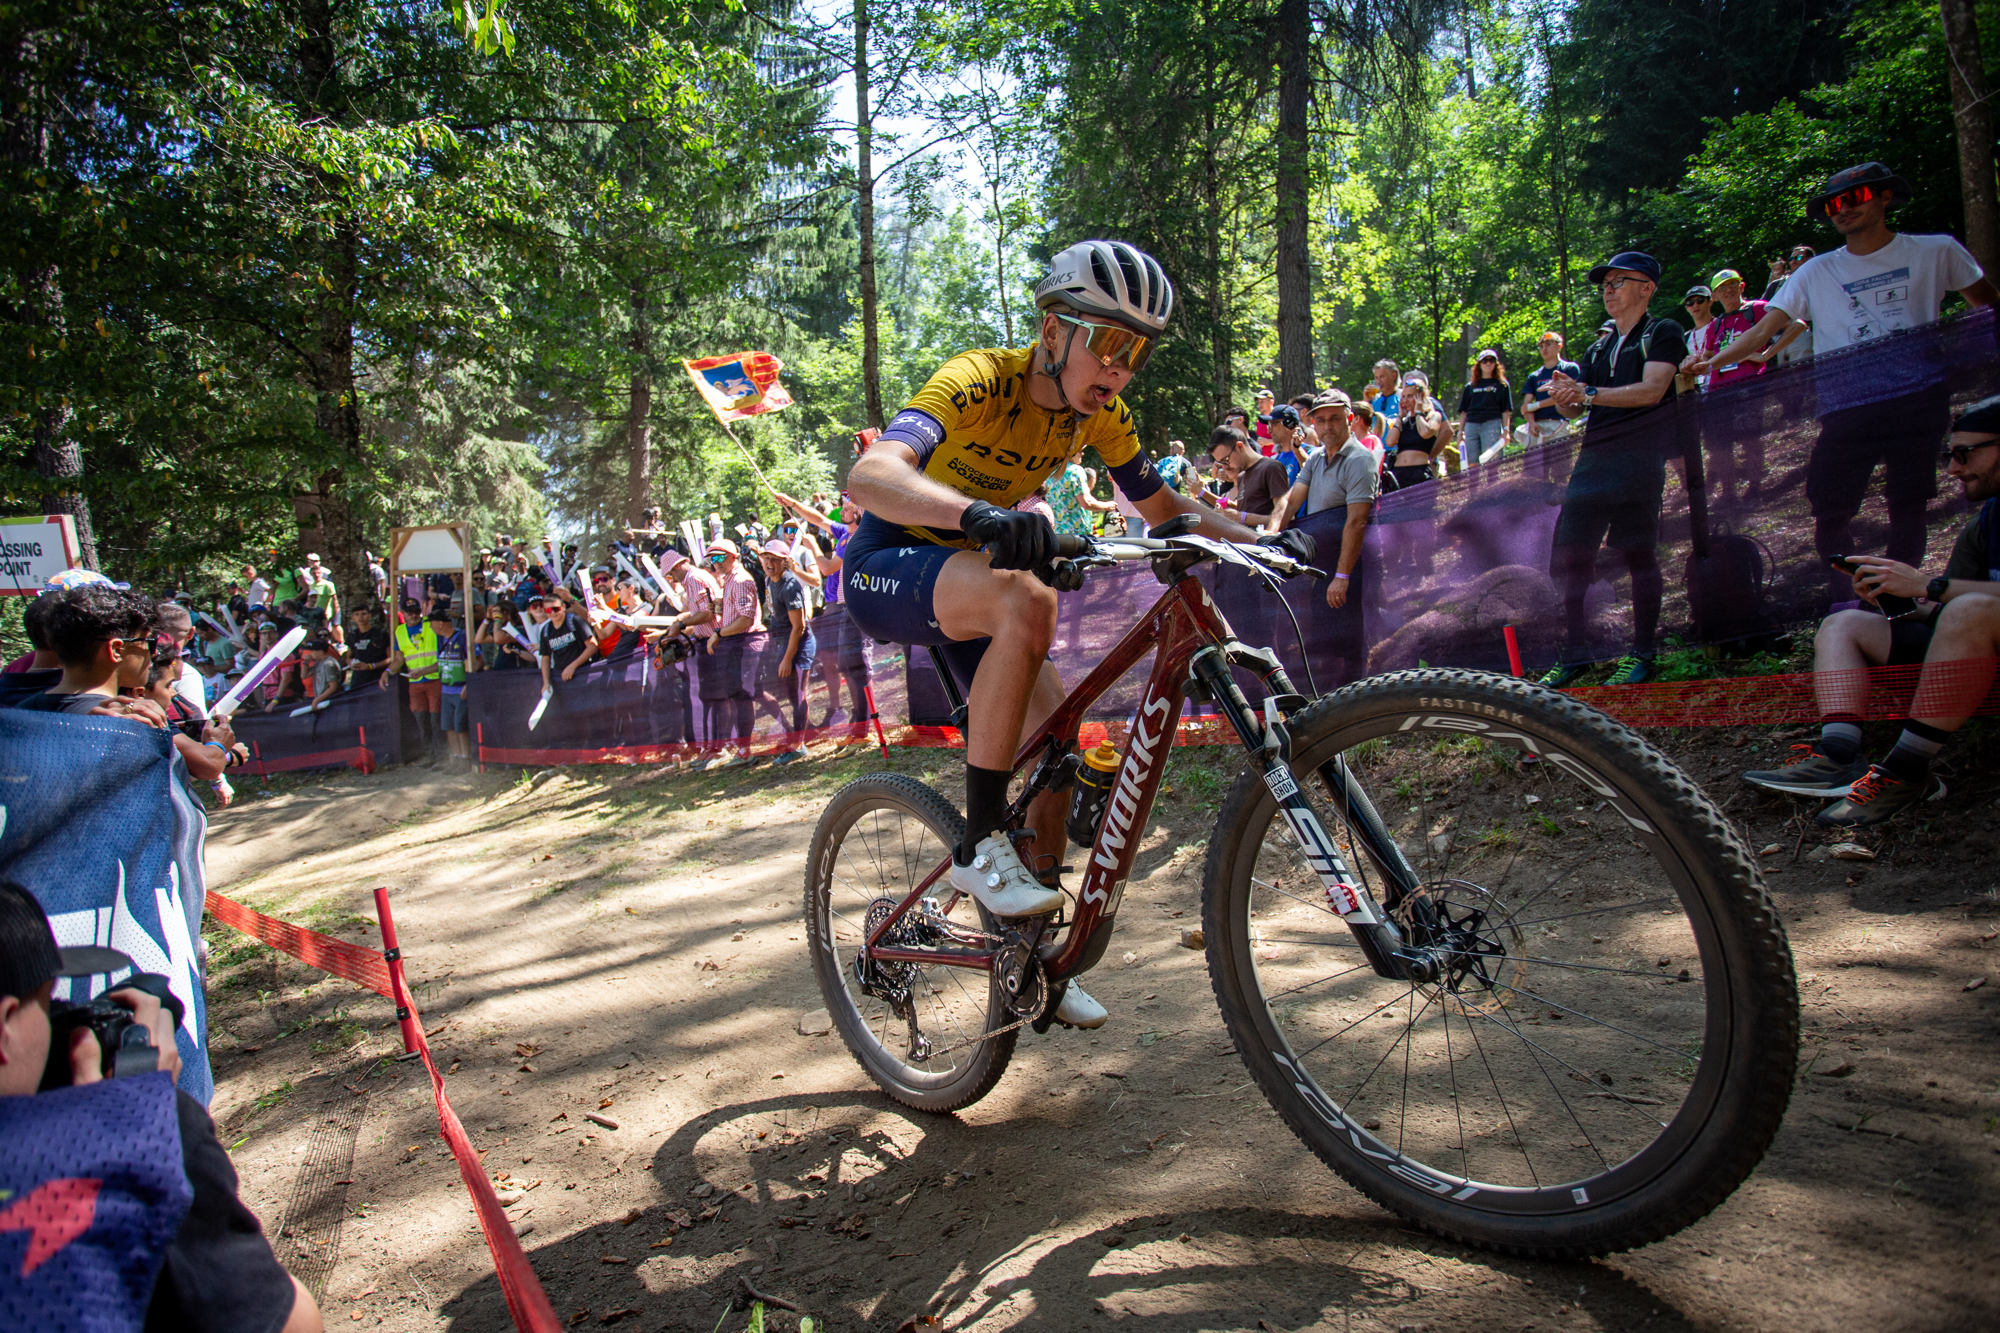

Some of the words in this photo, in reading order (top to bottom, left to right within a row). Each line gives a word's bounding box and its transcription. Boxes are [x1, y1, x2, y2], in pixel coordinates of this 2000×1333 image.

[953, 457, 1012, 485] AUTOCENTRUM
[850, 571, 900, 595] ROUVY
[1420, 697, 1465, 710] FAST
[1470, 702, 1524, 725] TRAK
[1265, 769, 1289, 788] ROCK
[1273, 781, 1295, 798] SHOX
[1083, 682, 1171, 917] S-WORKS
